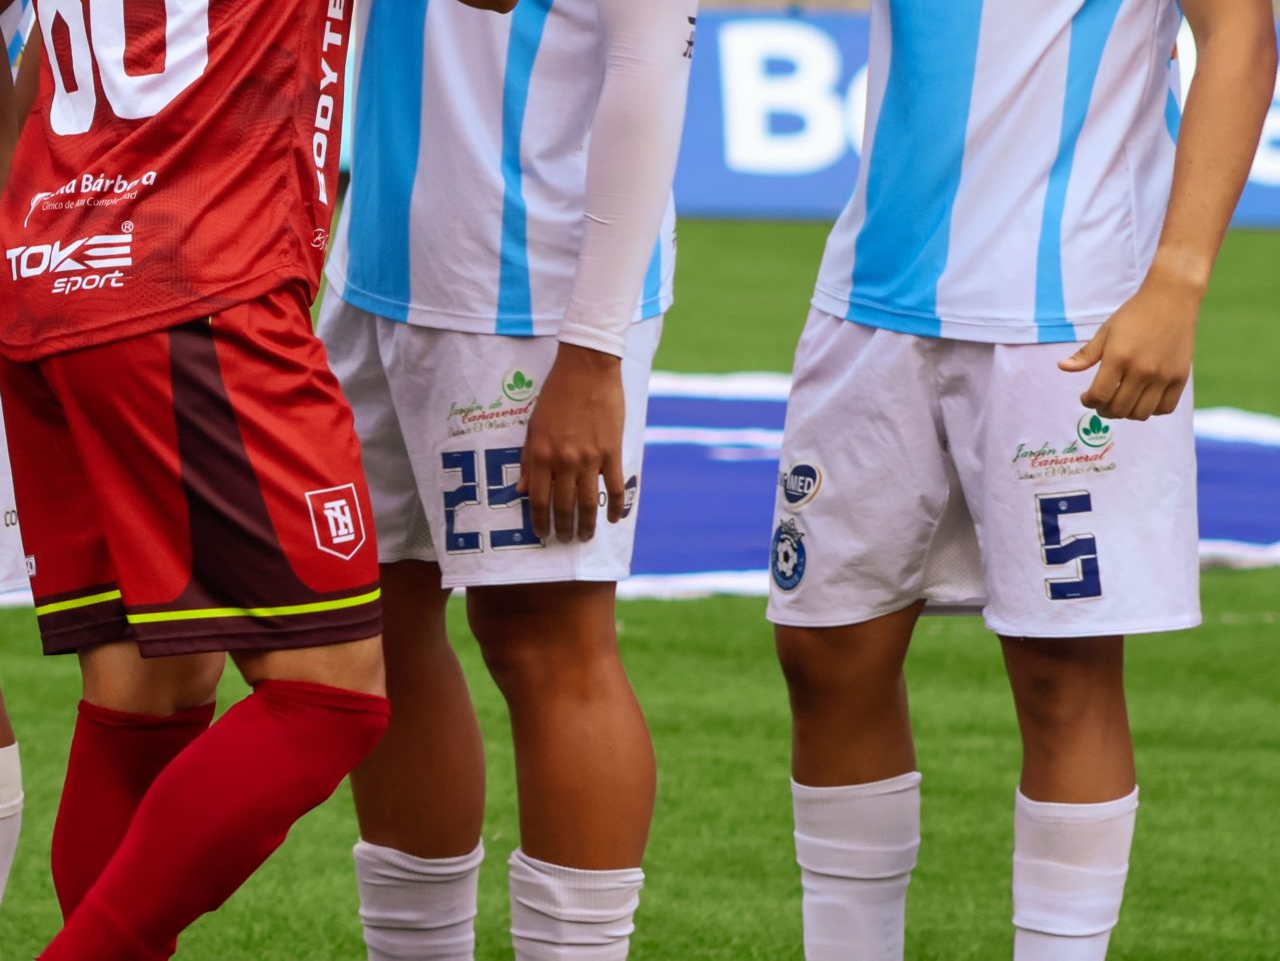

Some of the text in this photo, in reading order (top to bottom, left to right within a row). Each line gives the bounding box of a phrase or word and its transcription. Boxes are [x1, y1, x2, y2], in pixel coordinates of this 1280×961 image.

[51, 269, 125, 295] sport
[1030, 441, 1115, 469] Cañaveral
[1035, 489, 1103, 601] 5
